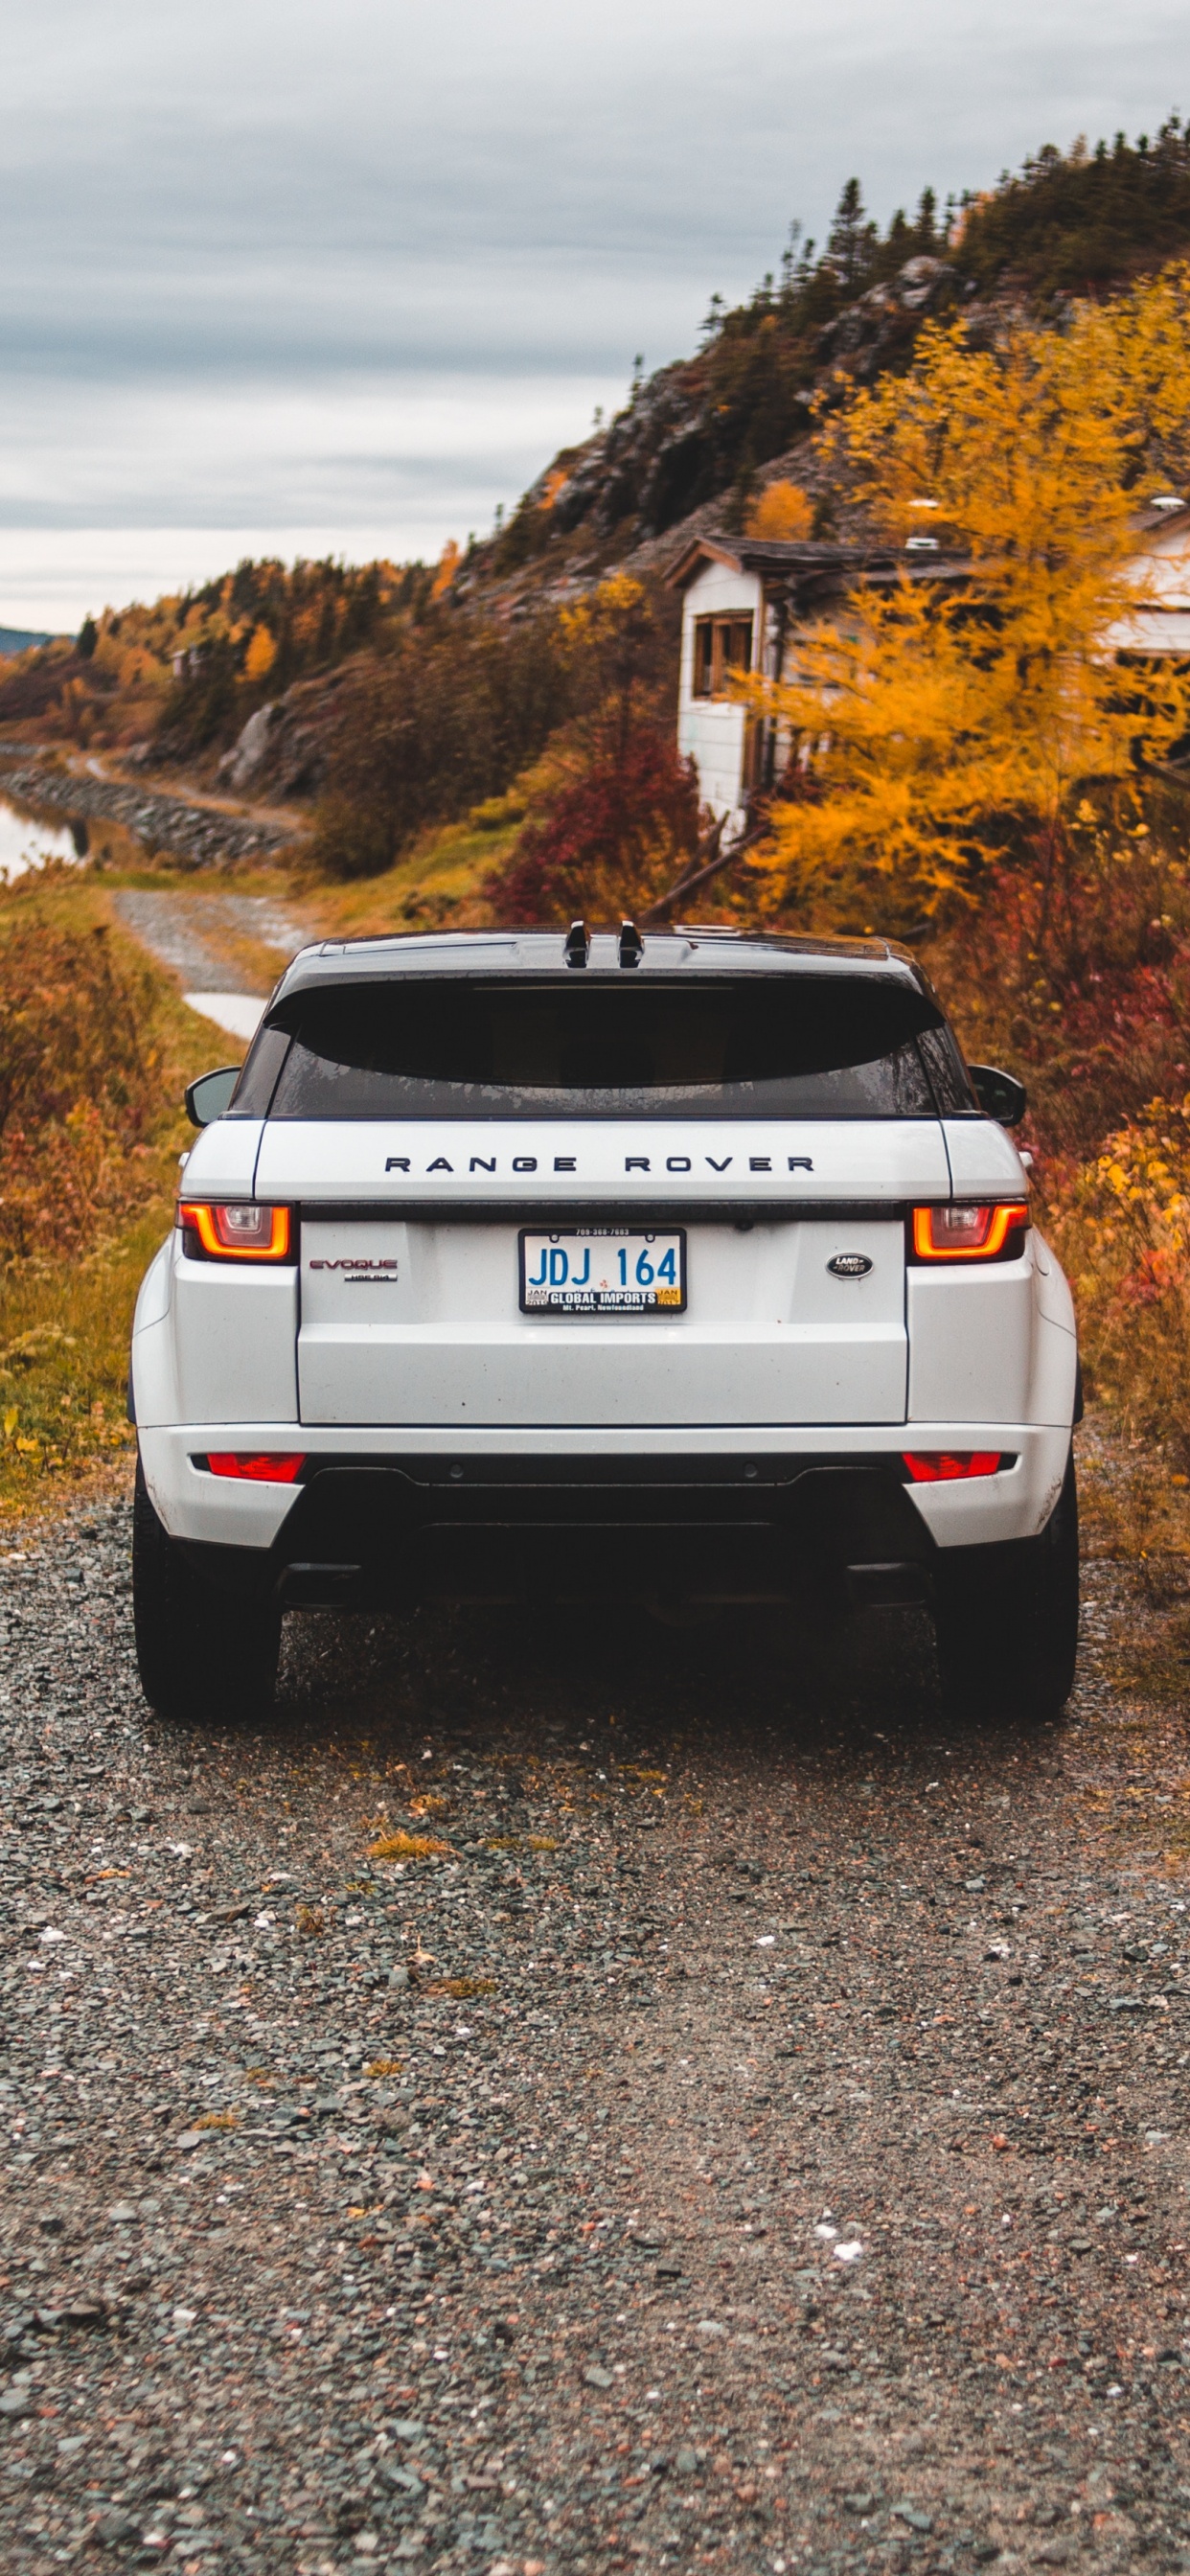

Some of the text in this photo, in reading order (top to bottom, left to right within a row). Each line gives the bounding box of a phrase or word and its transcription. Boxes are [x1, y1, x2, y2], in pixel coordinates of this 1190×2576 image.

[384, 1157, 814, 1173] RANGE ROVER
[309, 1259, 398, 1270] EVOQUE
[528, 1248, 676, 1286] JDJ 164
[550, 1292, 656, 1304] GLOBAL IMPORTS
